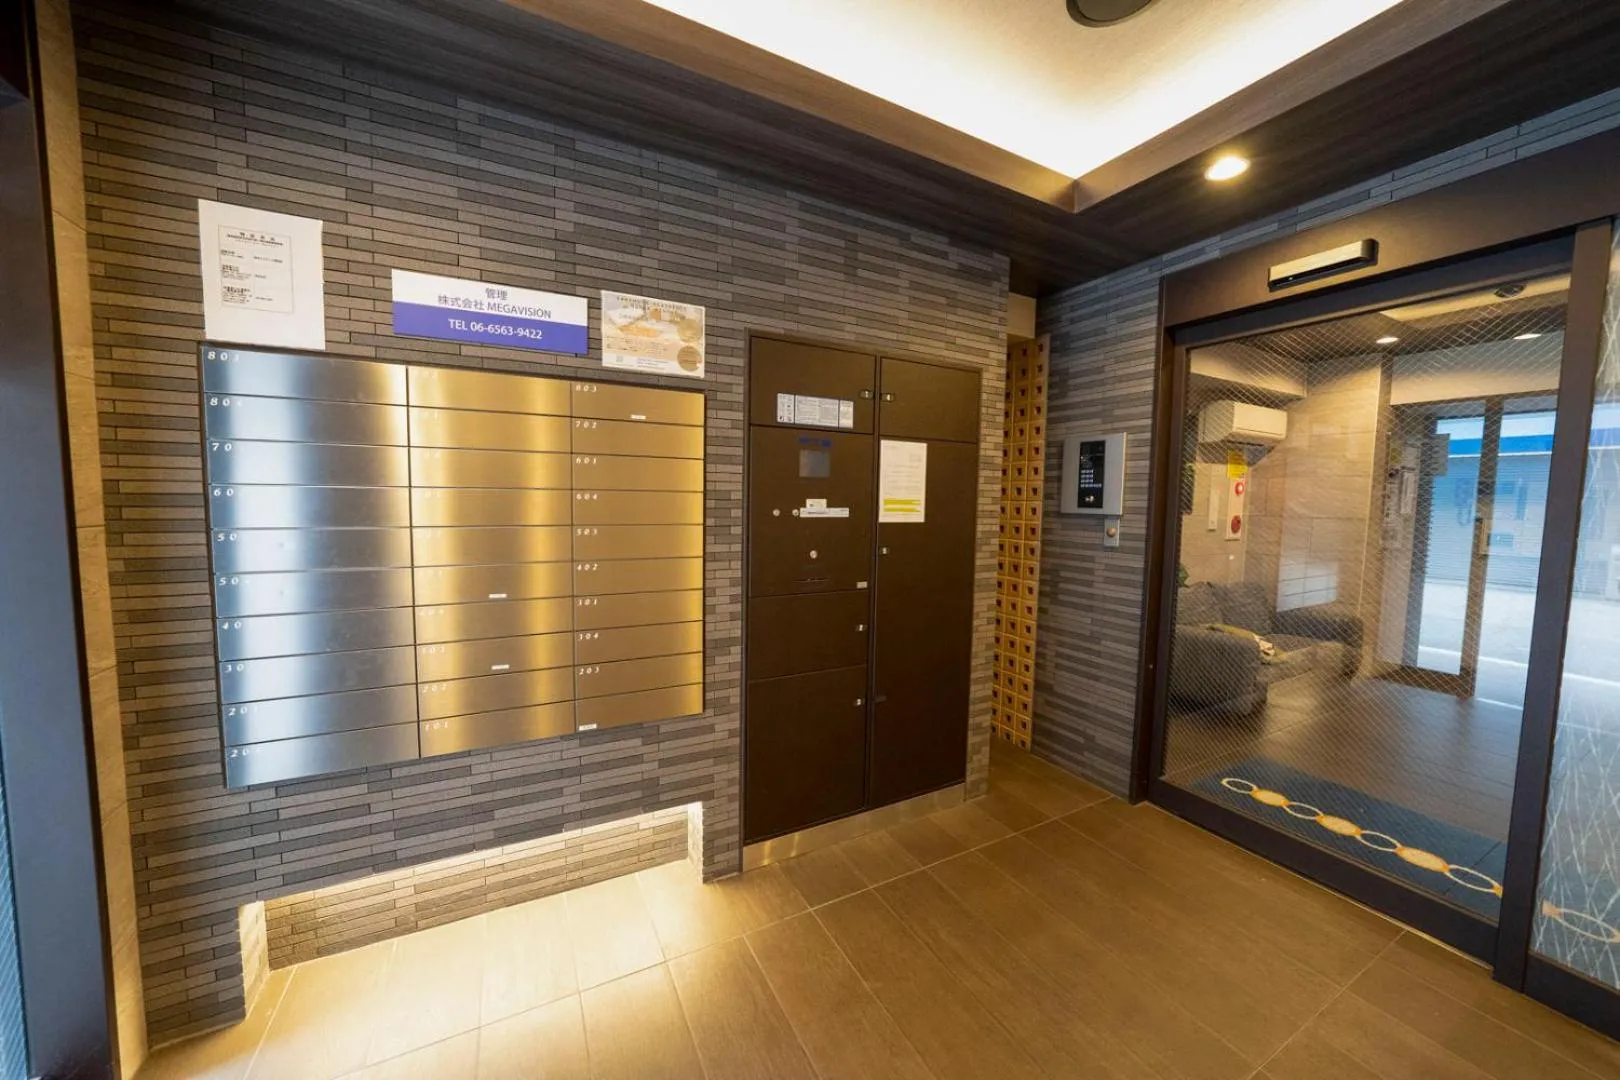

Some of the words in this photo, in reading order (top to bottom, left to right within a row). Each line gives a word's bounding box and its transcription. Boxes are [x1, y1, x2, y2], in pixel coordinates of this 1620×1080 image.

[485, 287, 508, 300] 管理
[438, 294, 486, 311] 株式会社
[487, 301, 552, 319] MEGAVISION
[448, 318, 468, 331] TEL
[470, 322, 543, 340] 06-6563-9422
